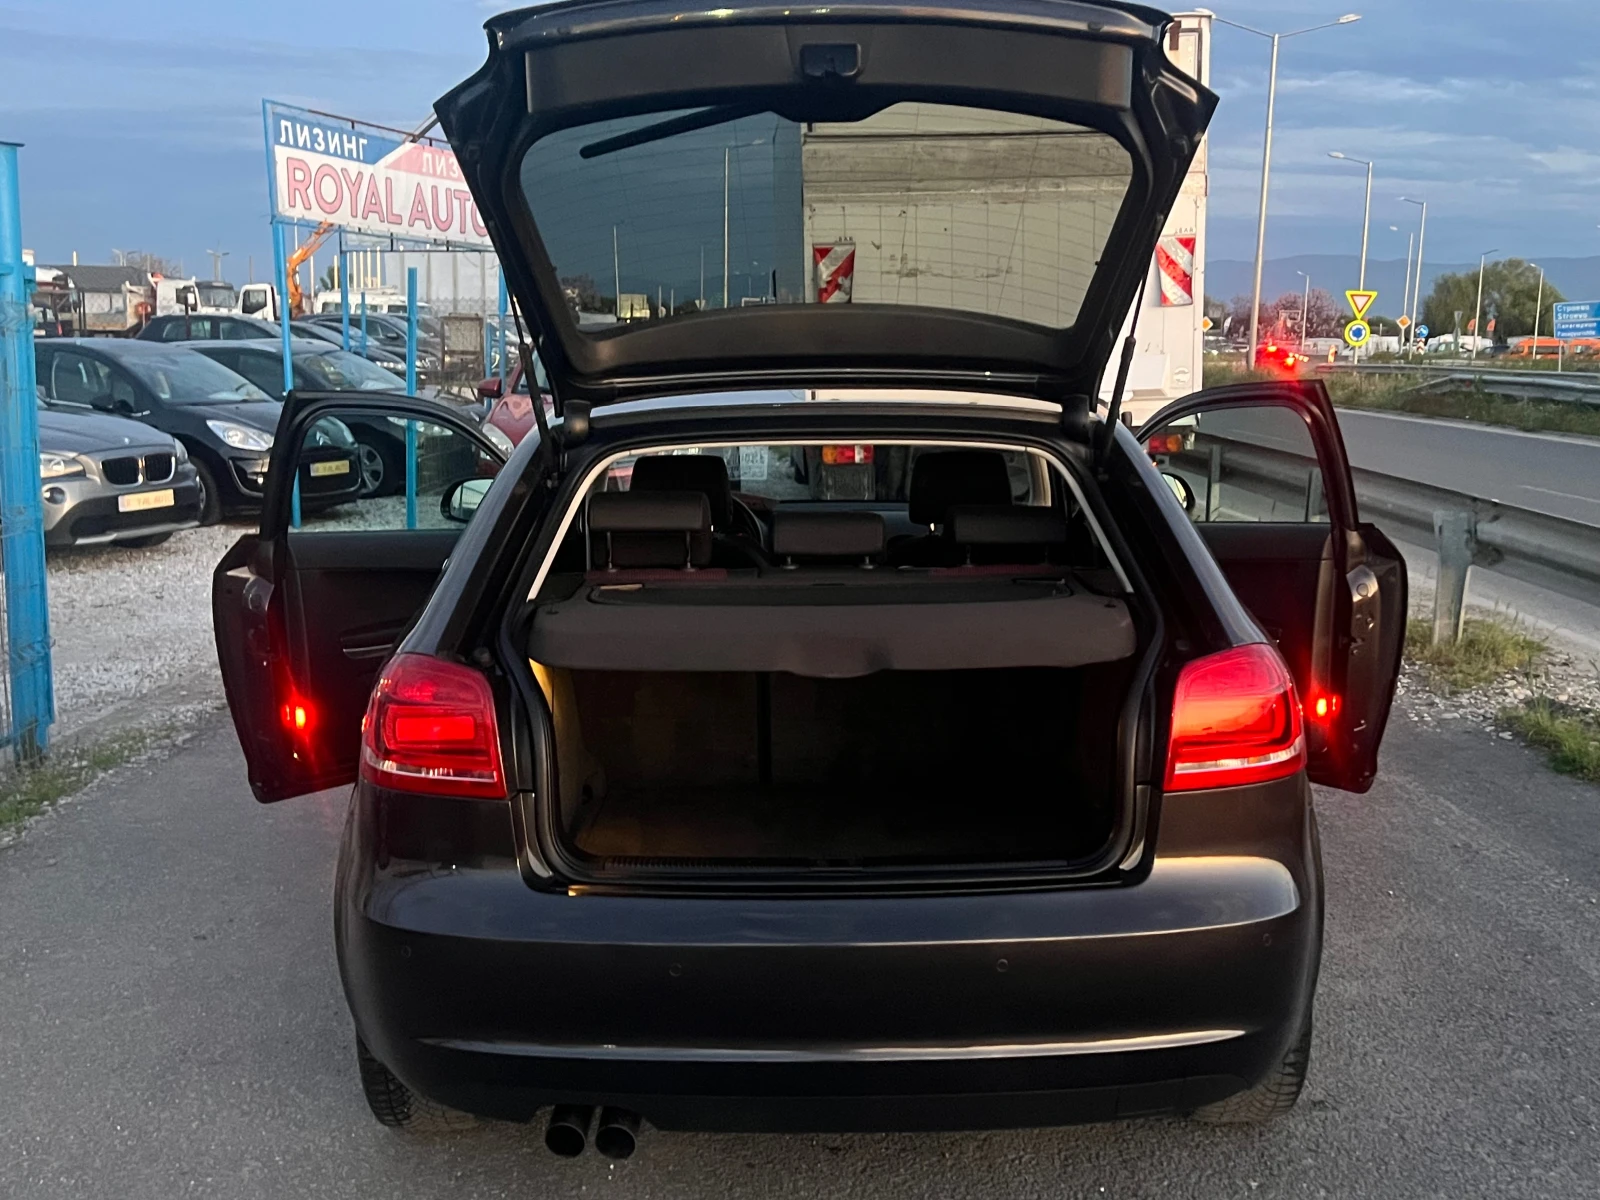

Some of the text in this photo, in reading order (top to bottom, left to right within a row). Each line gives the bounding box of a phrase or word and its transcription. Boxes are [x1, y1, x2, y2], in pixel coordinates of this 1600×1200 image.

[279, 119, 368, 161] ЛИЗИНГ
[421, 152, 459, 178] ЛИЗ
[286, 156, 403, 225] ROYAL
